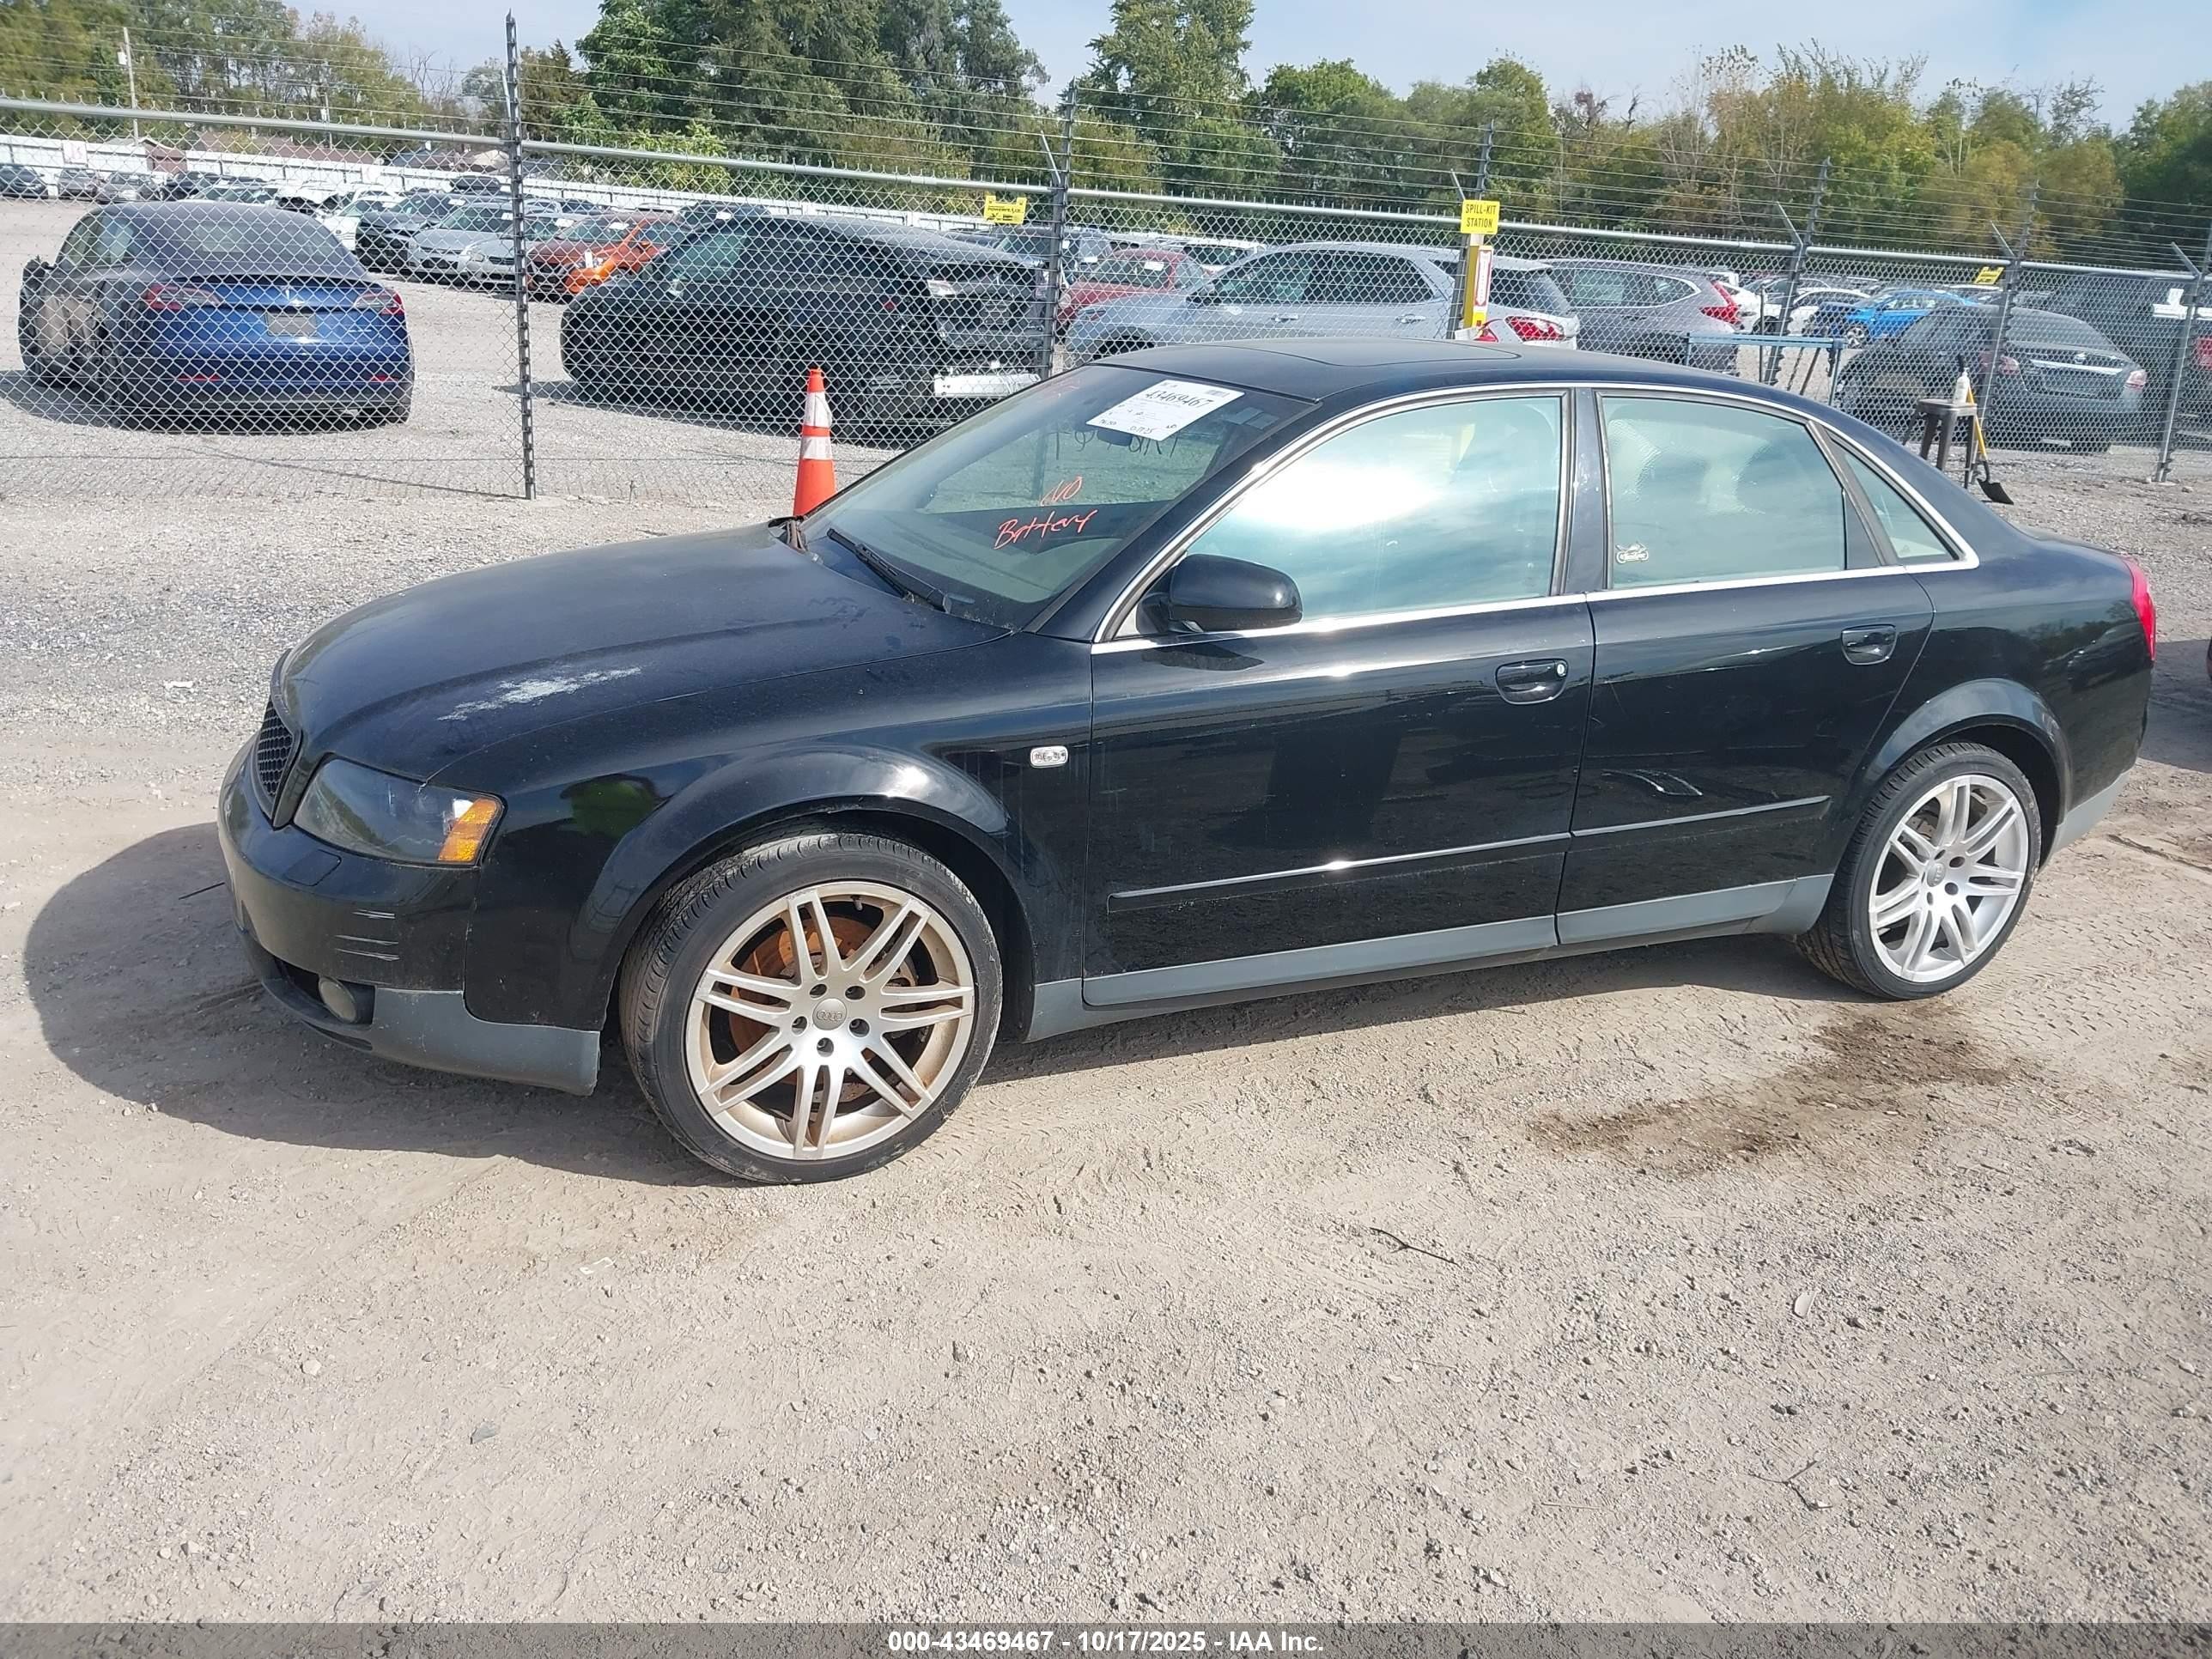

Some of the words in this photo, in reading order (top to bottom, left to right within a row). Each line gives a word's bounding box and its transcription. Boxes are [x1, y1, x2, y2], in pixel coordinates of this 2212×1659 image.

[1466, 204, 1496, 215] SPILL-KIT
[1467, 217, 1492, 228] STATION
[1145, 390, 1215, 409] 43469467
